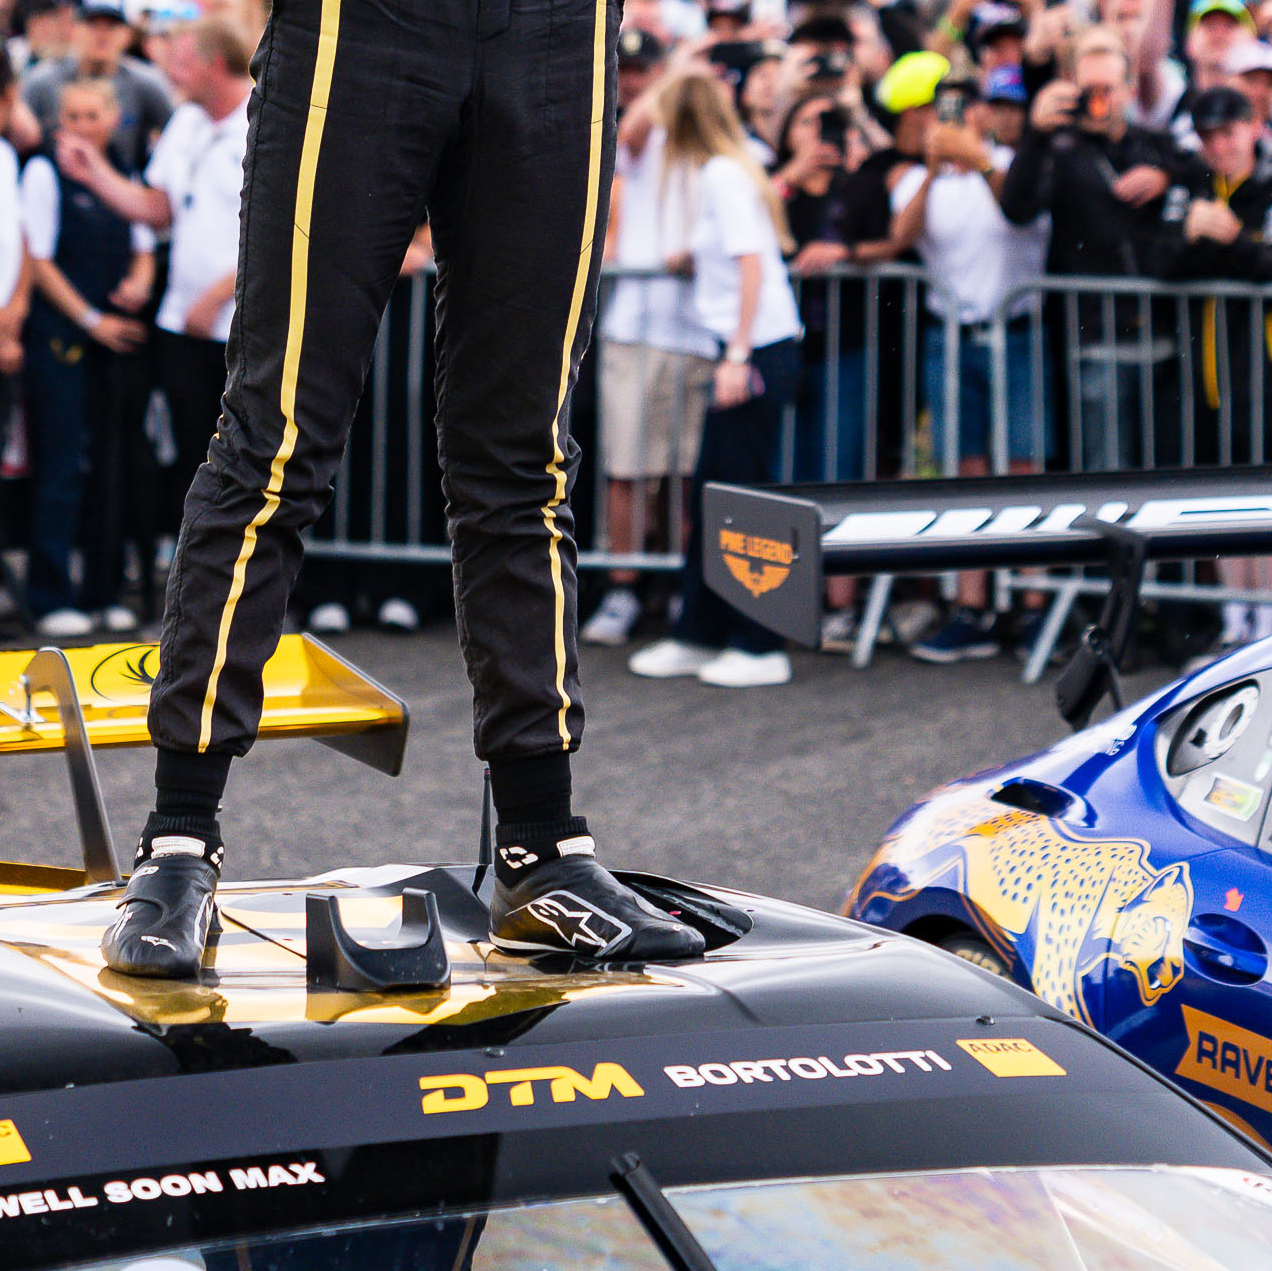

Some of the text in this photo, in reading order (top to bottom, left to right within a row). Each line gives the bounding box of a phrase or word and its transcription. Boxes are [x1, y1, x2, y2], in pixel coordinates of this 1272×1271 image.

[747, 535, 793, 565] LEGEND
[966, 1039, 1033, 1057] ADAC
[418, 1061, 646, 1116] DTM
[662, 1049, 953, 1089] BORTOLOTTI
[105, 1169, 224, 1205] SOON
[229, 1161, 326, 1191] MAX
